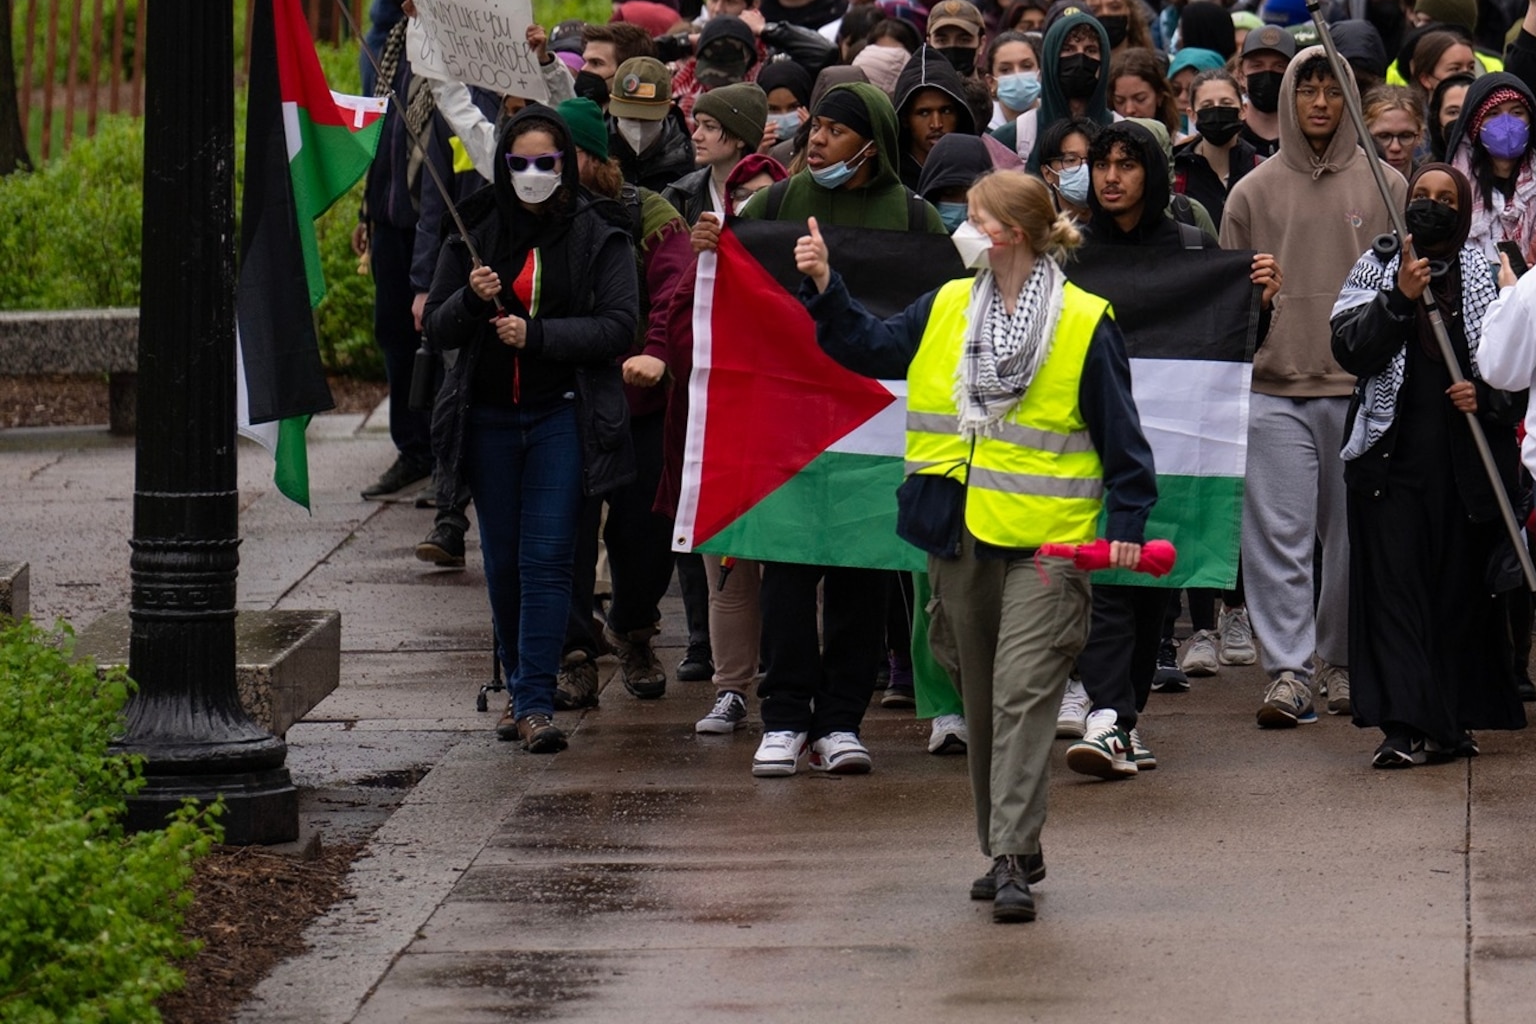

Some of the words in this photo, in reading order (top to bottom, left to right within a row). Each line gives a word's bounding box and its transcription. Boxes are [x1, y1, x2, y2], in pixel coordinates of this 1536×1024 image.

[483, 11, 512, 40] YOU
[443, 29, 478, 59] THE
[474, 37, 537, 75] MURDER
